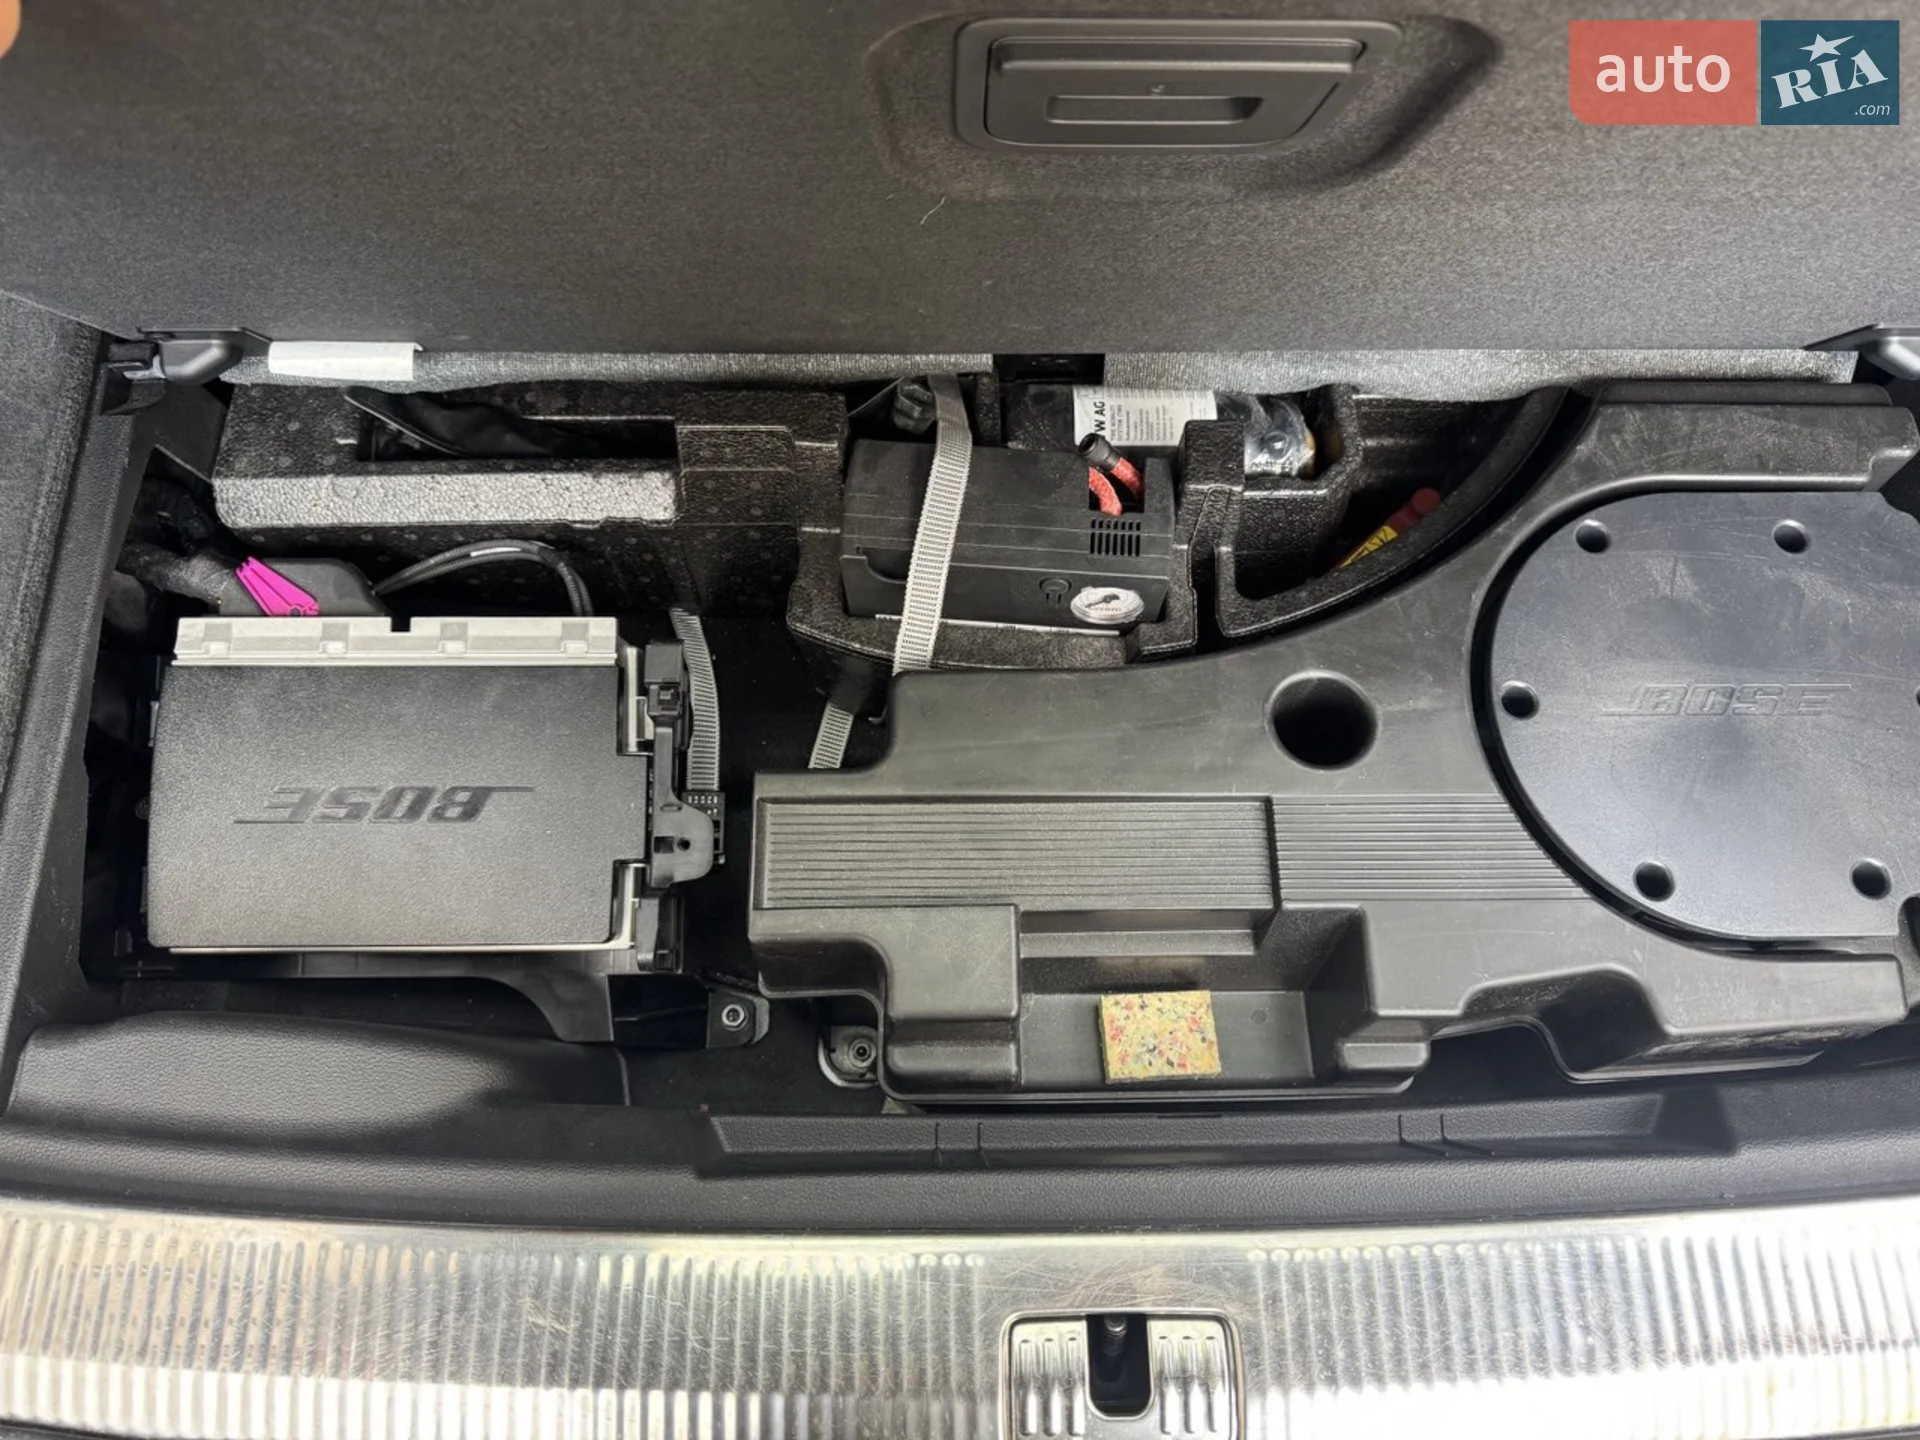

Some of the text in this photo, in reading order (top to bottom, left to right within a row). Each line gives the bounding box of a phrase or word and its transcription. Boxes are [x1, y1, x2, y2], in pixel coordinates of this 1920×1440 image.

[1093, 401, 1105, 417] AG
[1602, 683, 1851, 716] BOSE
[233, 786, 534, 824] BOSE
